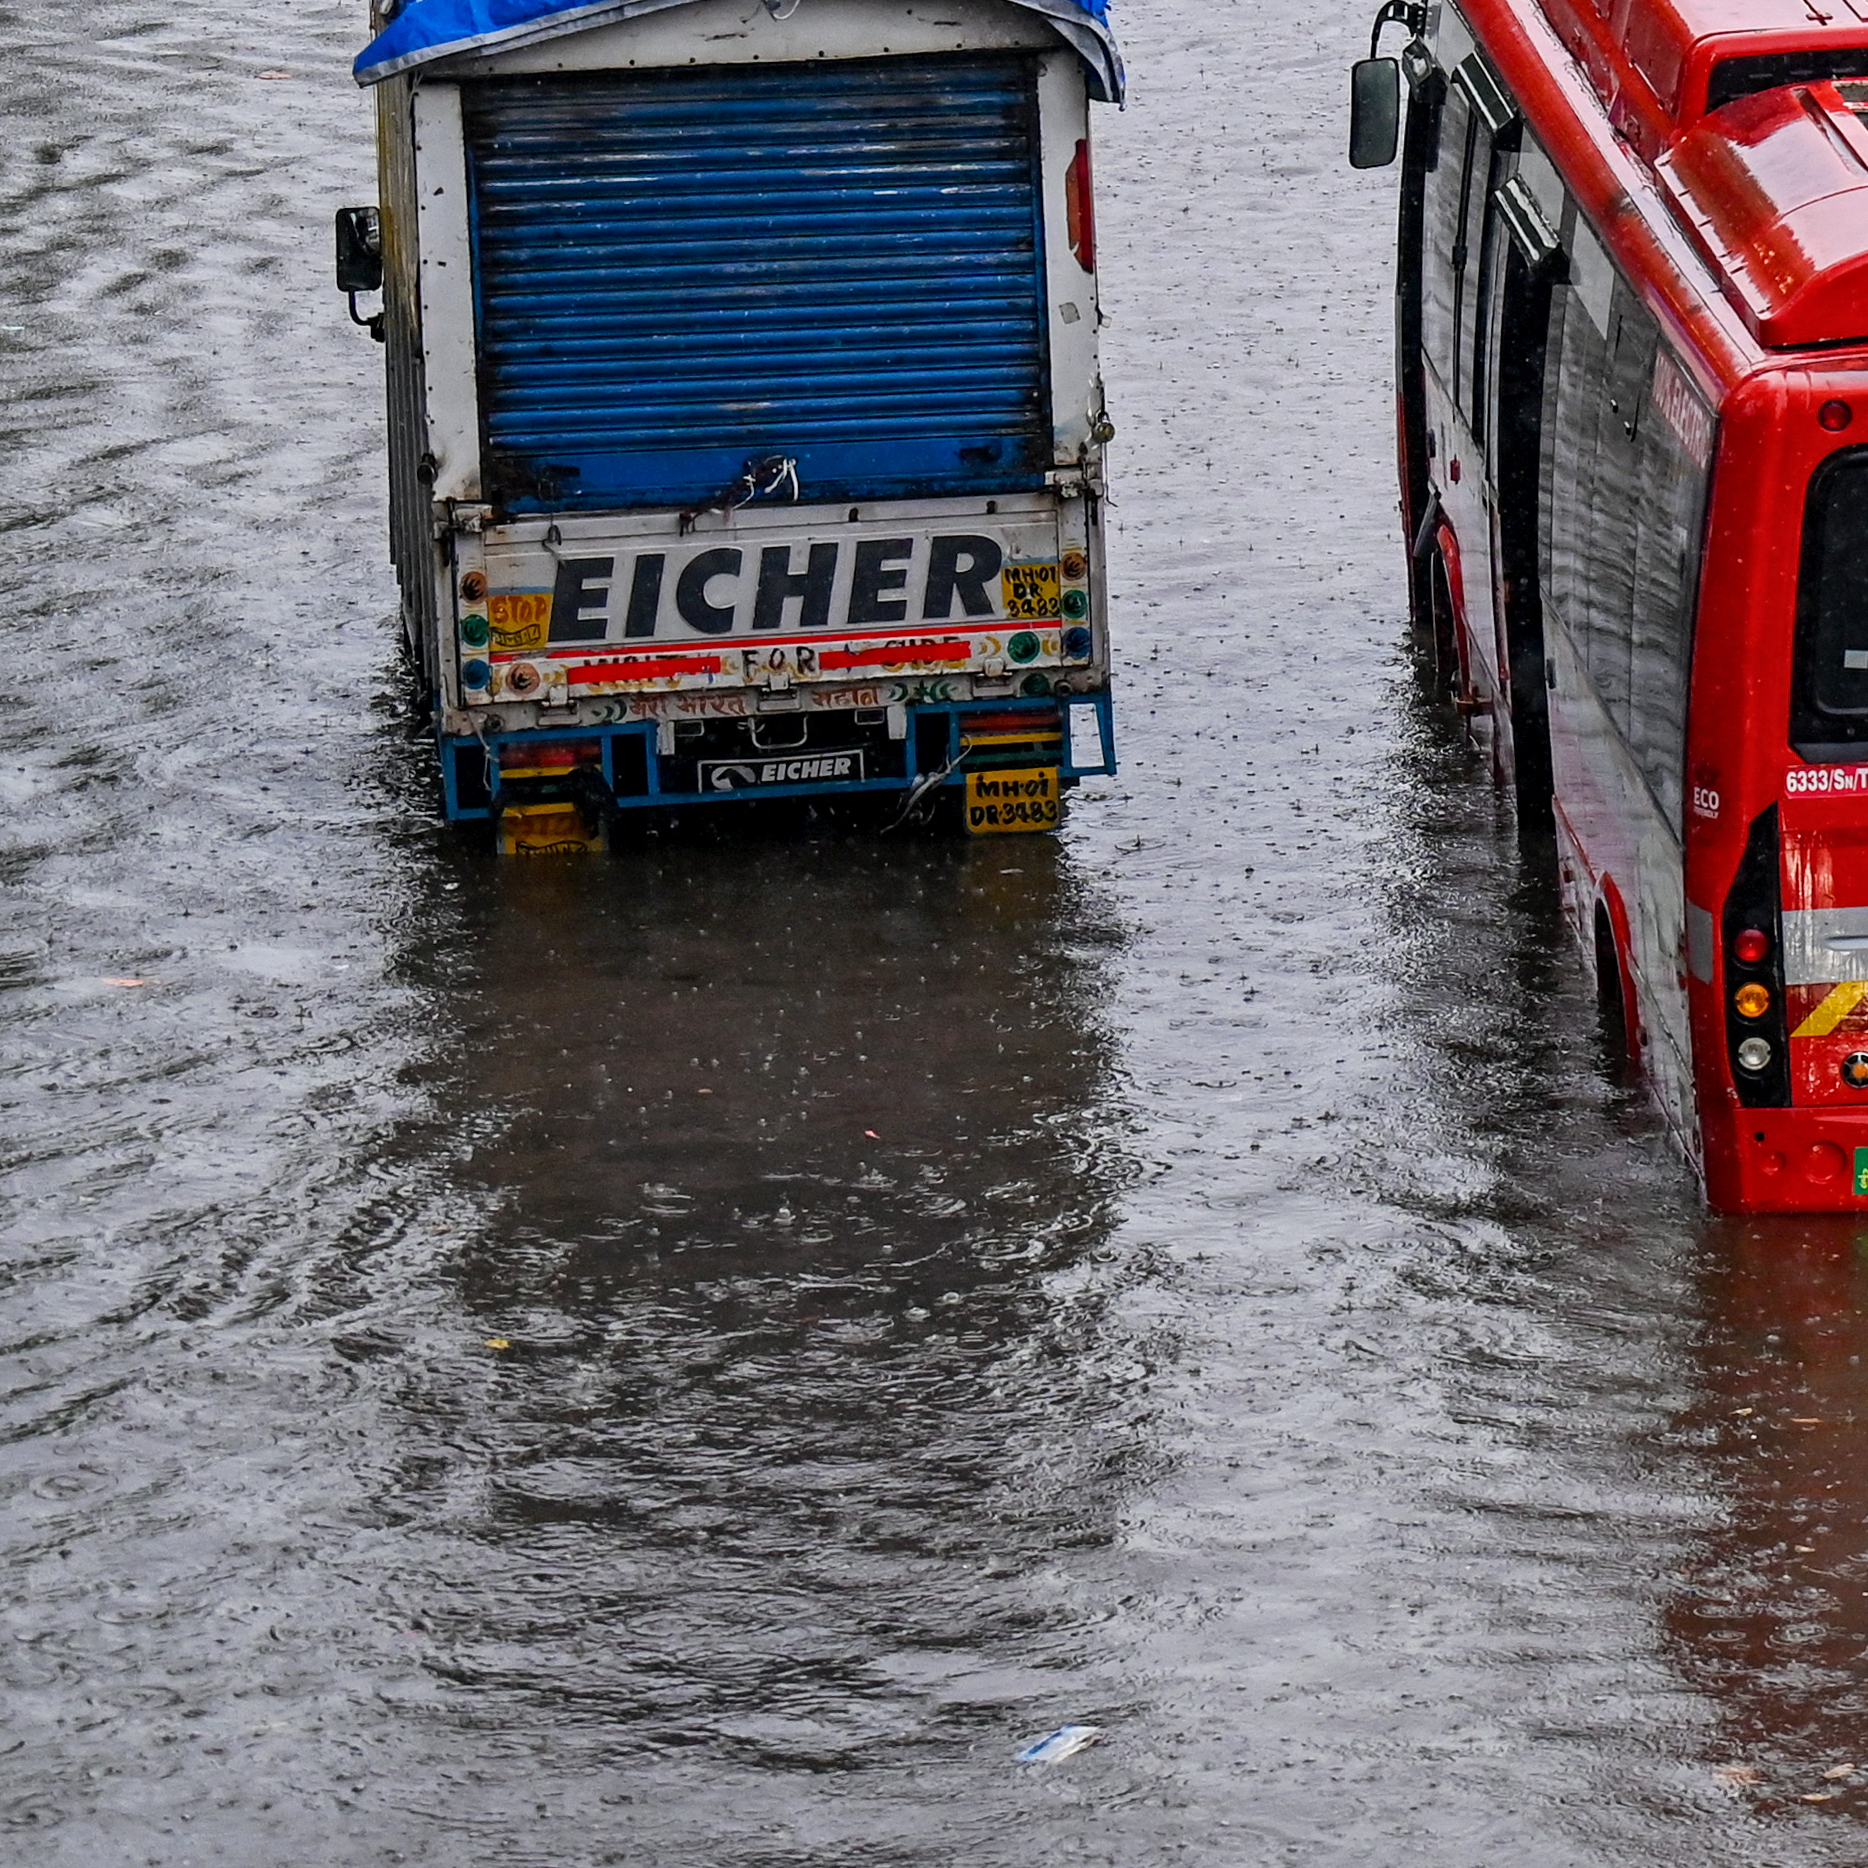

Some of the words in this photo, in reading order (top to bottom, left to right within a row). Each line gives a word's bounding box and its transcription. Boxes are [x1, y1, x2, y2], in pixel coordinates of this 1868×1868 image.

[549, 534, 1001, 642] EICHER
[491, 595, 549, 624] STOP
[761, 756, 852, 783] EICHER
[1694, 787, 1719, 810] ECO
